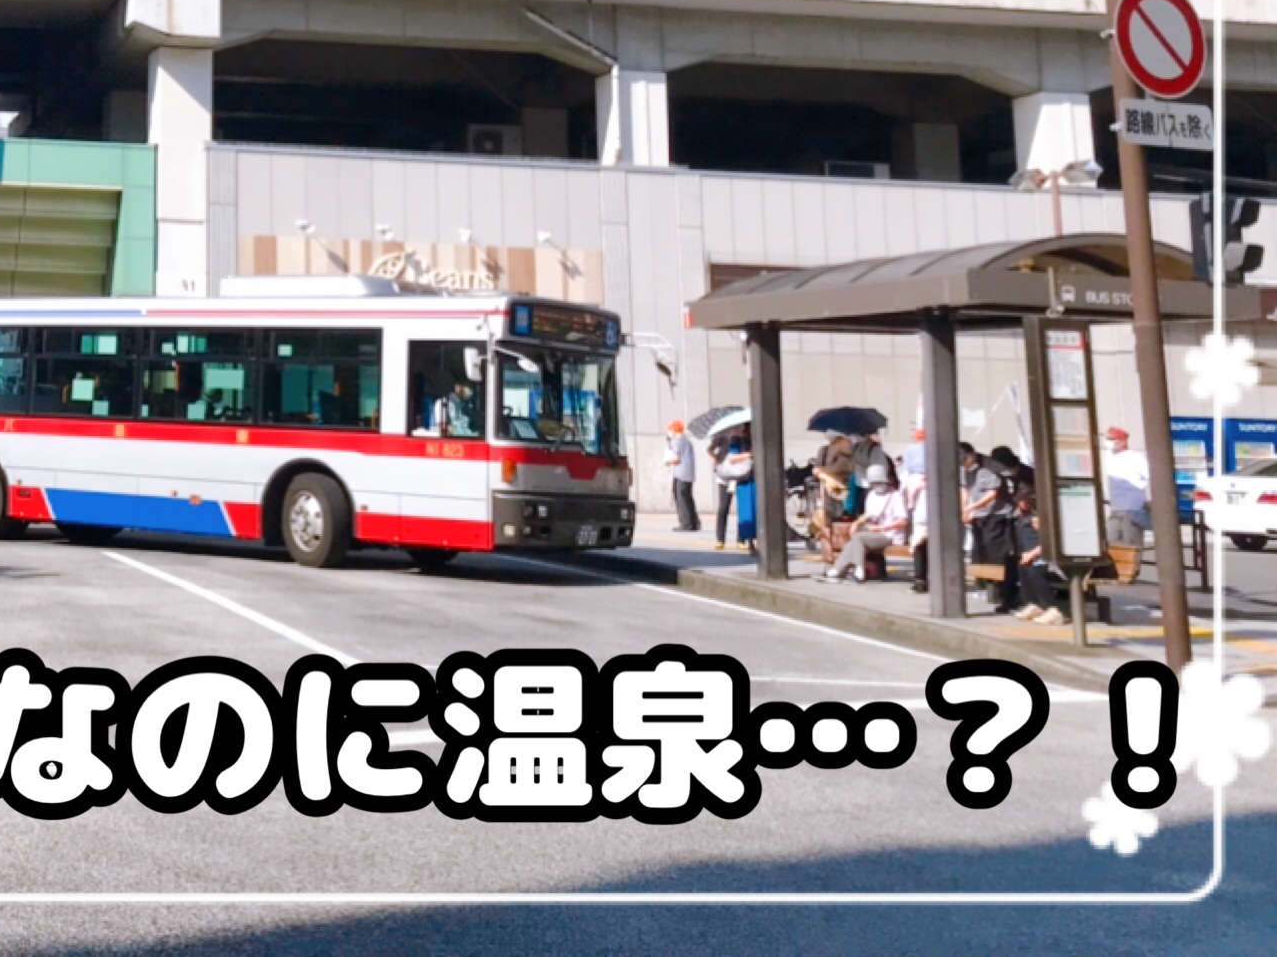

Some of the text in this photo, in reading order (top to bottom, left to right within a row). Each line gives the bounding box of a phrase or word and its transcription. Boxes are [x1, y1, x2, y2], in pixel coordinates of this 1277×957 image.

[1125, 109, 1211, 140] 路線バスを除く
[1085, 291, 1134, 305] BUS STO
